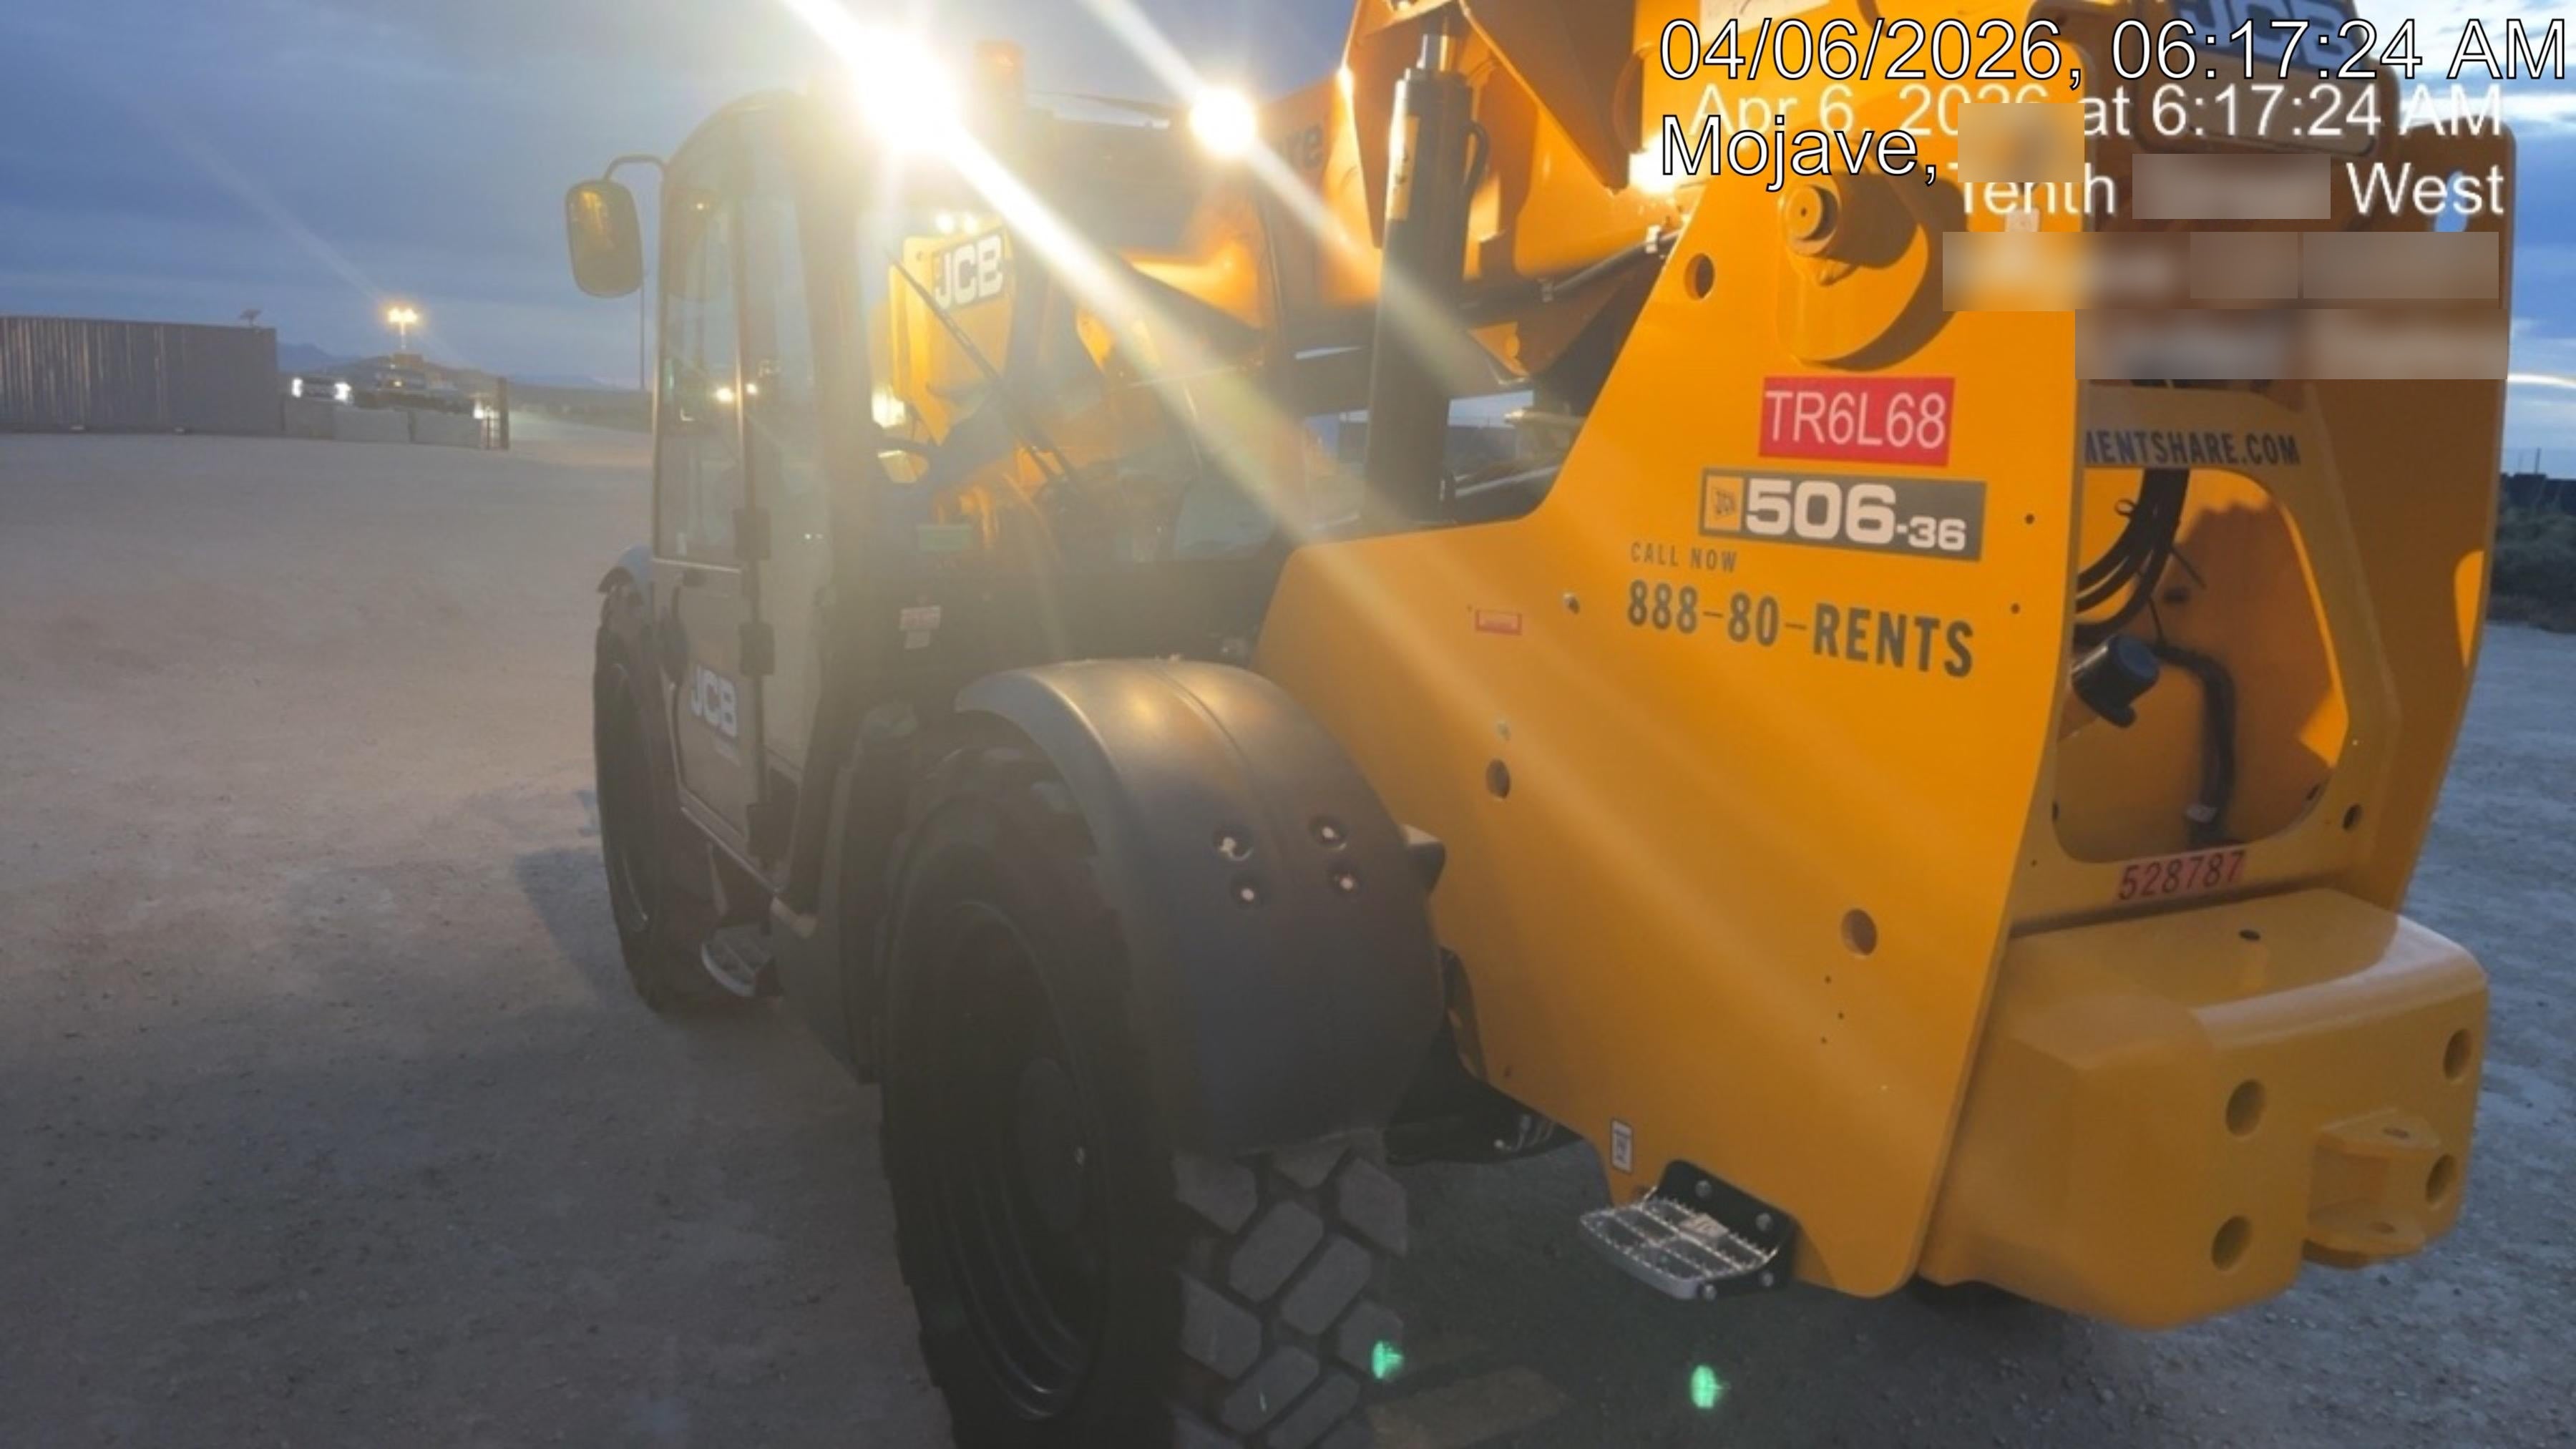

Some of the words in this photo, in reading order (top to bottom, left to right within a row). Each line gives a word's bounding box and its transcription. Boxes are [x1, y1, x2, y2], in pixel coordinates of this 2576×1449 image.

[935, 234, 1002, 310] JCB
[1765, 390, 1948, 451] TR6L68
[1746, 477, 1966, 552] 506-36
[1631, 541, 1679, 567] CALL
[1691, 547, 1737, 573] NOW
[1627, 579, 1974, 679] 888-80-RENTS
[689, 665, 739, 738] JCB
[2119, 850, 2245, 900] 528787
